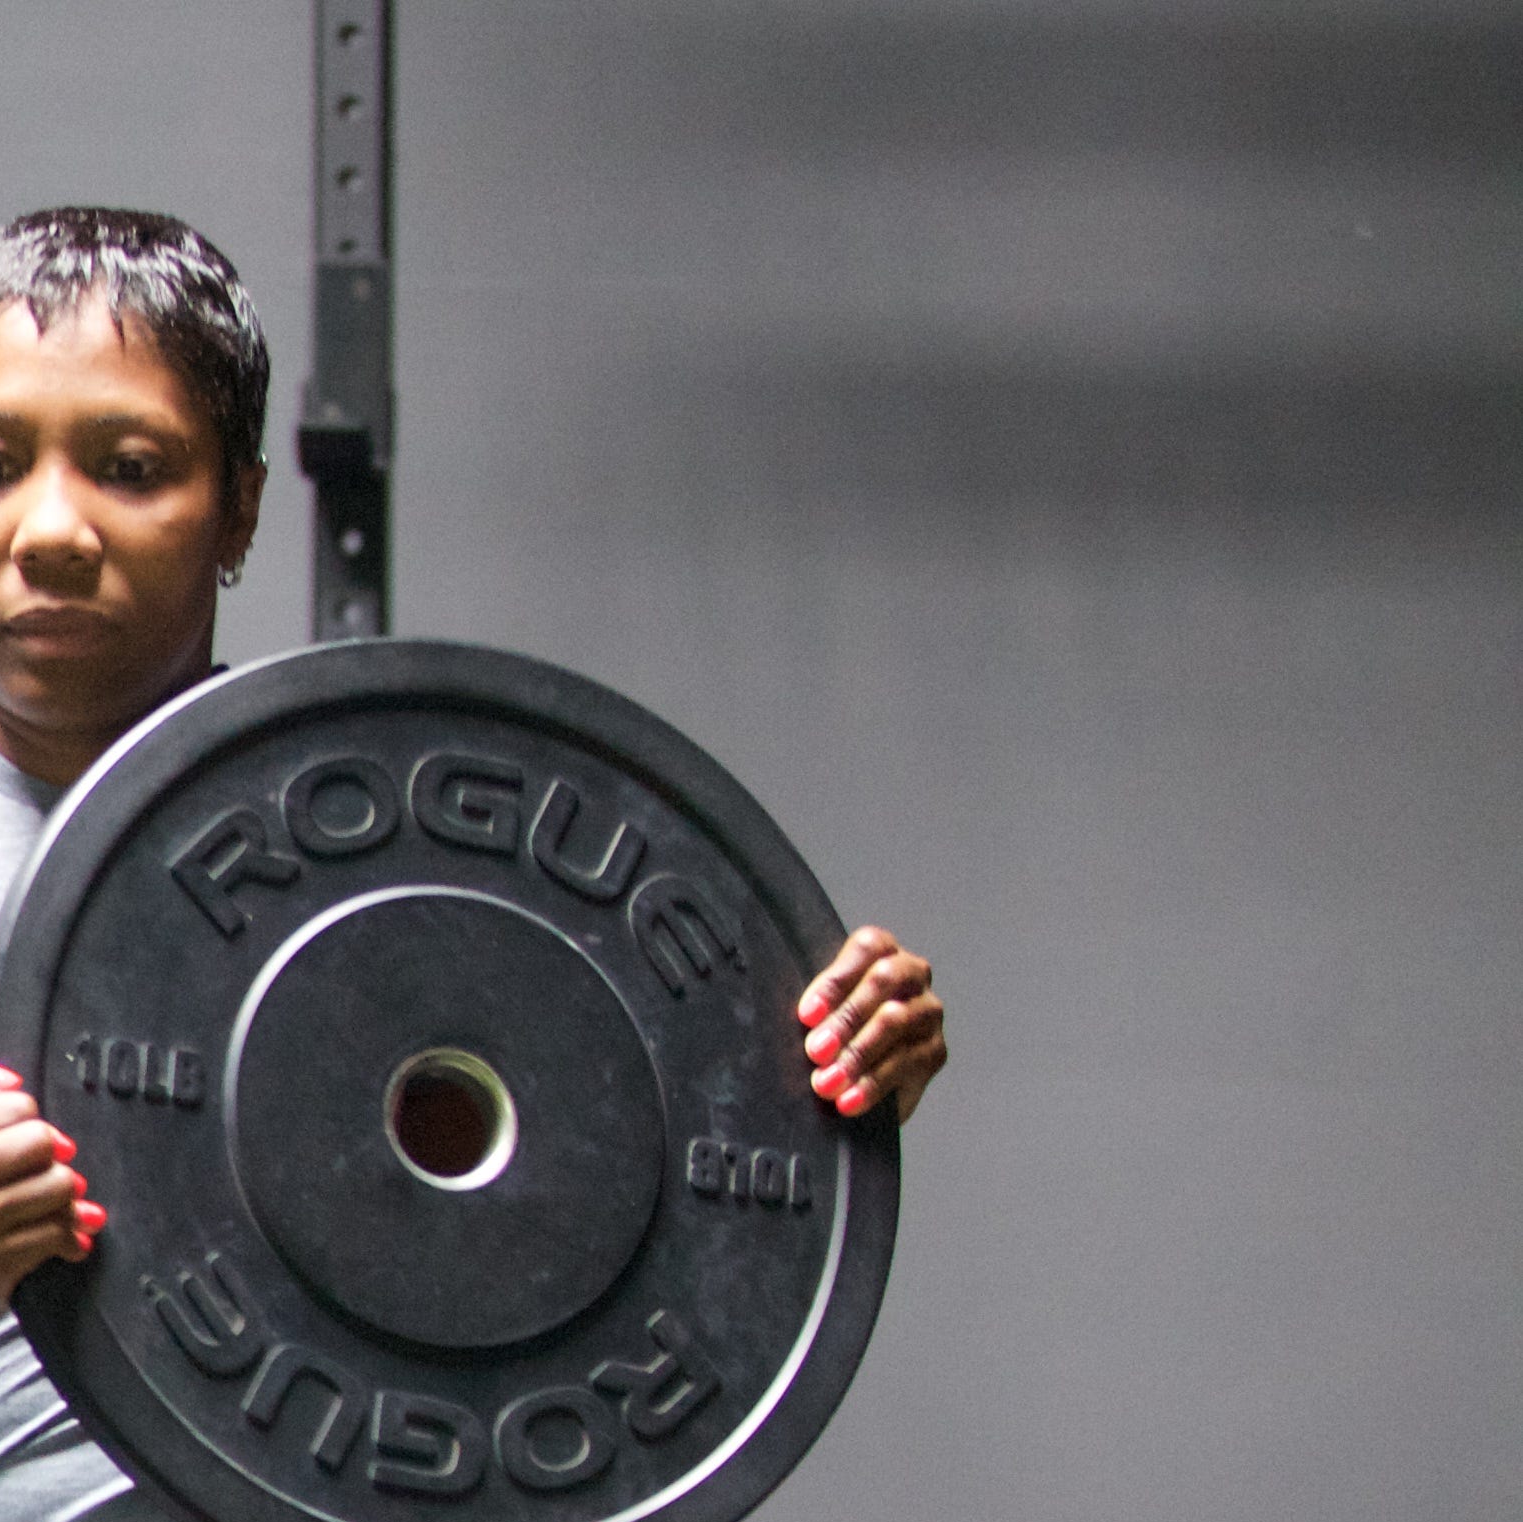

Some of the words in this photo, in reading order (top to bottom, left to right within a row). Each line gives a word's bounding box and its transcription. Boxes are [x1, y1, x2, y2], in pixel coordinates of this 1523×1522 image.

[170, 751, 747, 999] ROGUE
[75, 1034, 207, 1110] 10LB
[686, 1136, 814, 1210] 10LB
[140, 1252, 724, 1497] ROGUE
